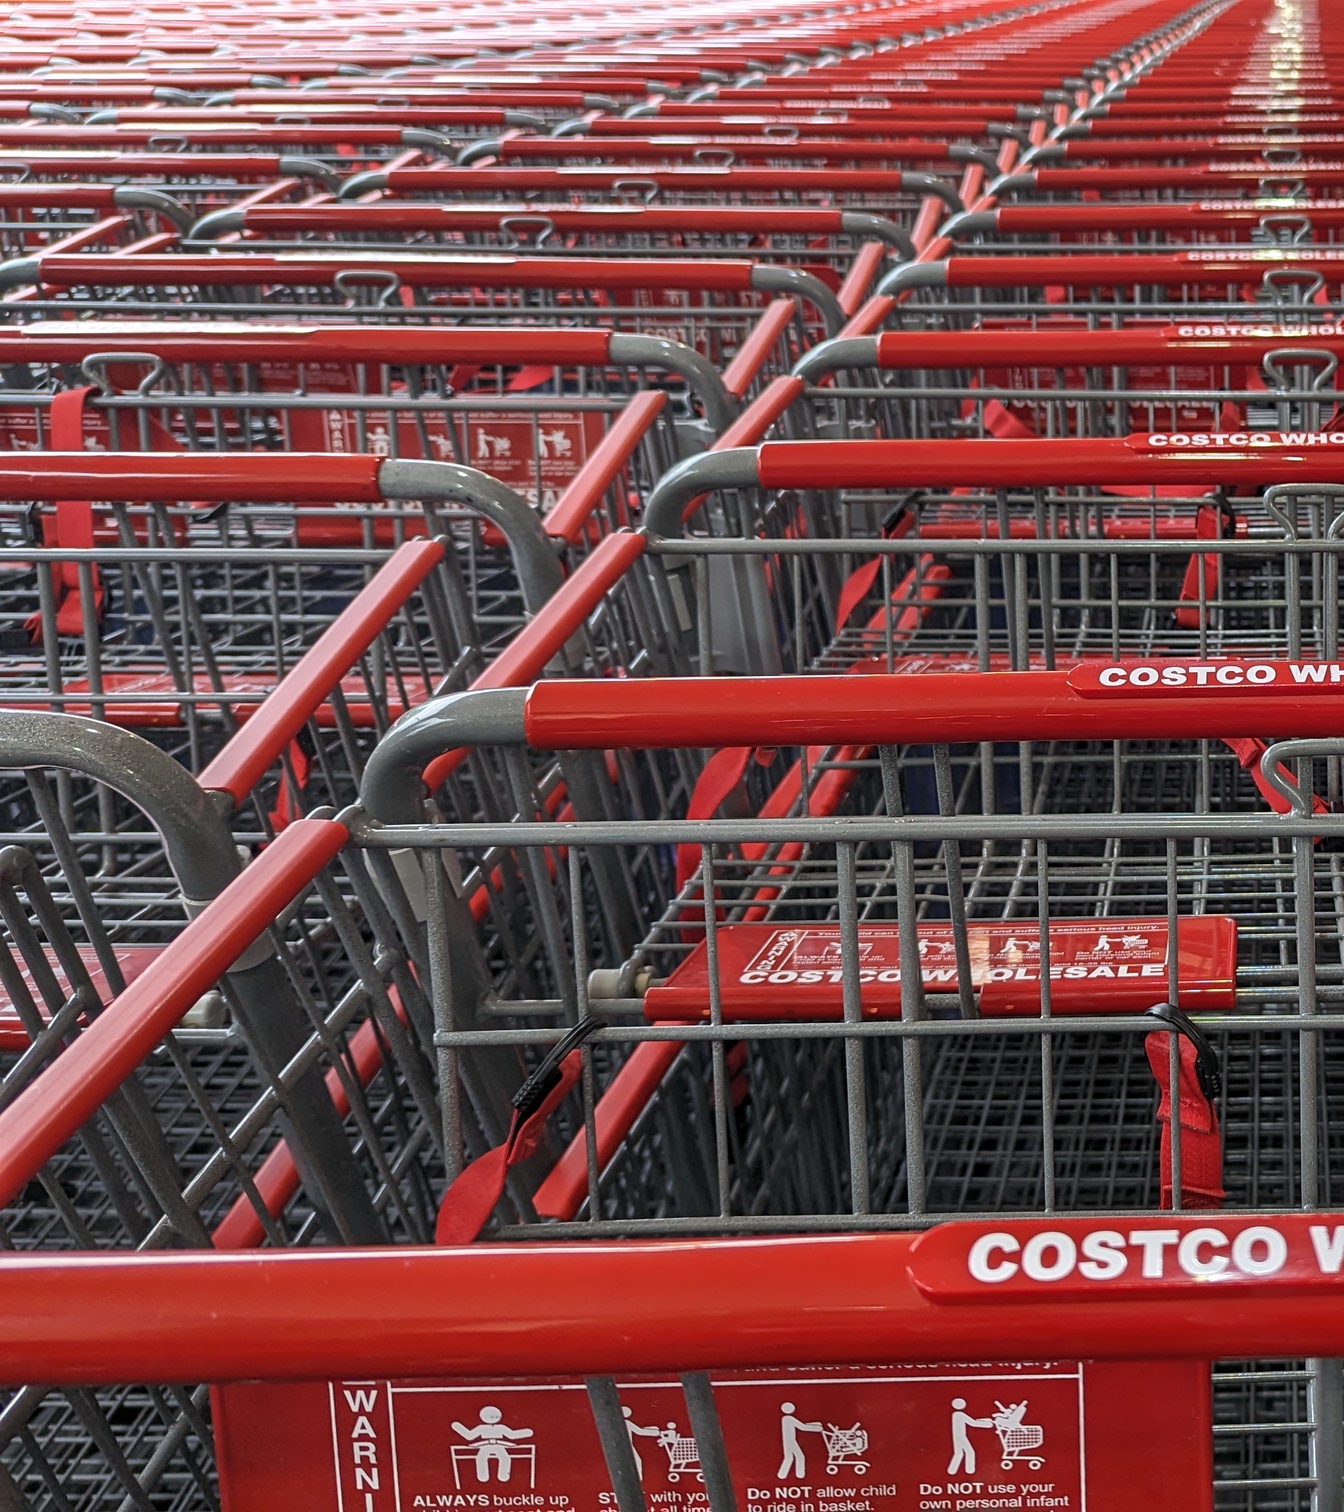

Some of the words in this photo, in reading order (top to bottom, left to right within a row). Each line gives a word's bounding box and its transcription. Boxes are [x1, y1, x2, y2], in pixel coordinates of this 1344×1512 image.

[1187, 251, 1265, 261] COSTC
[1178, 325, 1273, 336] COSTCO
[1148, 432, 1270, 446] COSTCO
[1098, 664, 1277, 687] COSTCO
[739, 970, 902, 984] COSTCO
[970, 1225, 1288, 1285] COSTCO
[747, 1488, 771, 1500] Do
[775, 1486, 813, 1499] NOT
[816, 1486, 857, 1498] allow
[860, 1484, 897, 1497] child
[919, 1483, 943, 1495] Do
[946, 1482, 985, 1495] NOT
[988, 1483, 1017, 1494] use
[1020, 1483, 1055, 1497] your
[413, 1494, 490, 1507] ALWAYS
[493, 1492, 545, 1507] buckle
[549, 1494, 570, 1508] up
[650, 1490, 682, 1503] with
[747, 1503, 763, 1512] to
[767, 1501, 797, 1512] ride
[800, 1501, 815, 1512] in
[818, 1499, 875, 1512] basket.
[919, 1500, 952, 1510] own
[956, 1496, 1022, 1512] personal
[1026, 1495, 1070, 1507] infant
